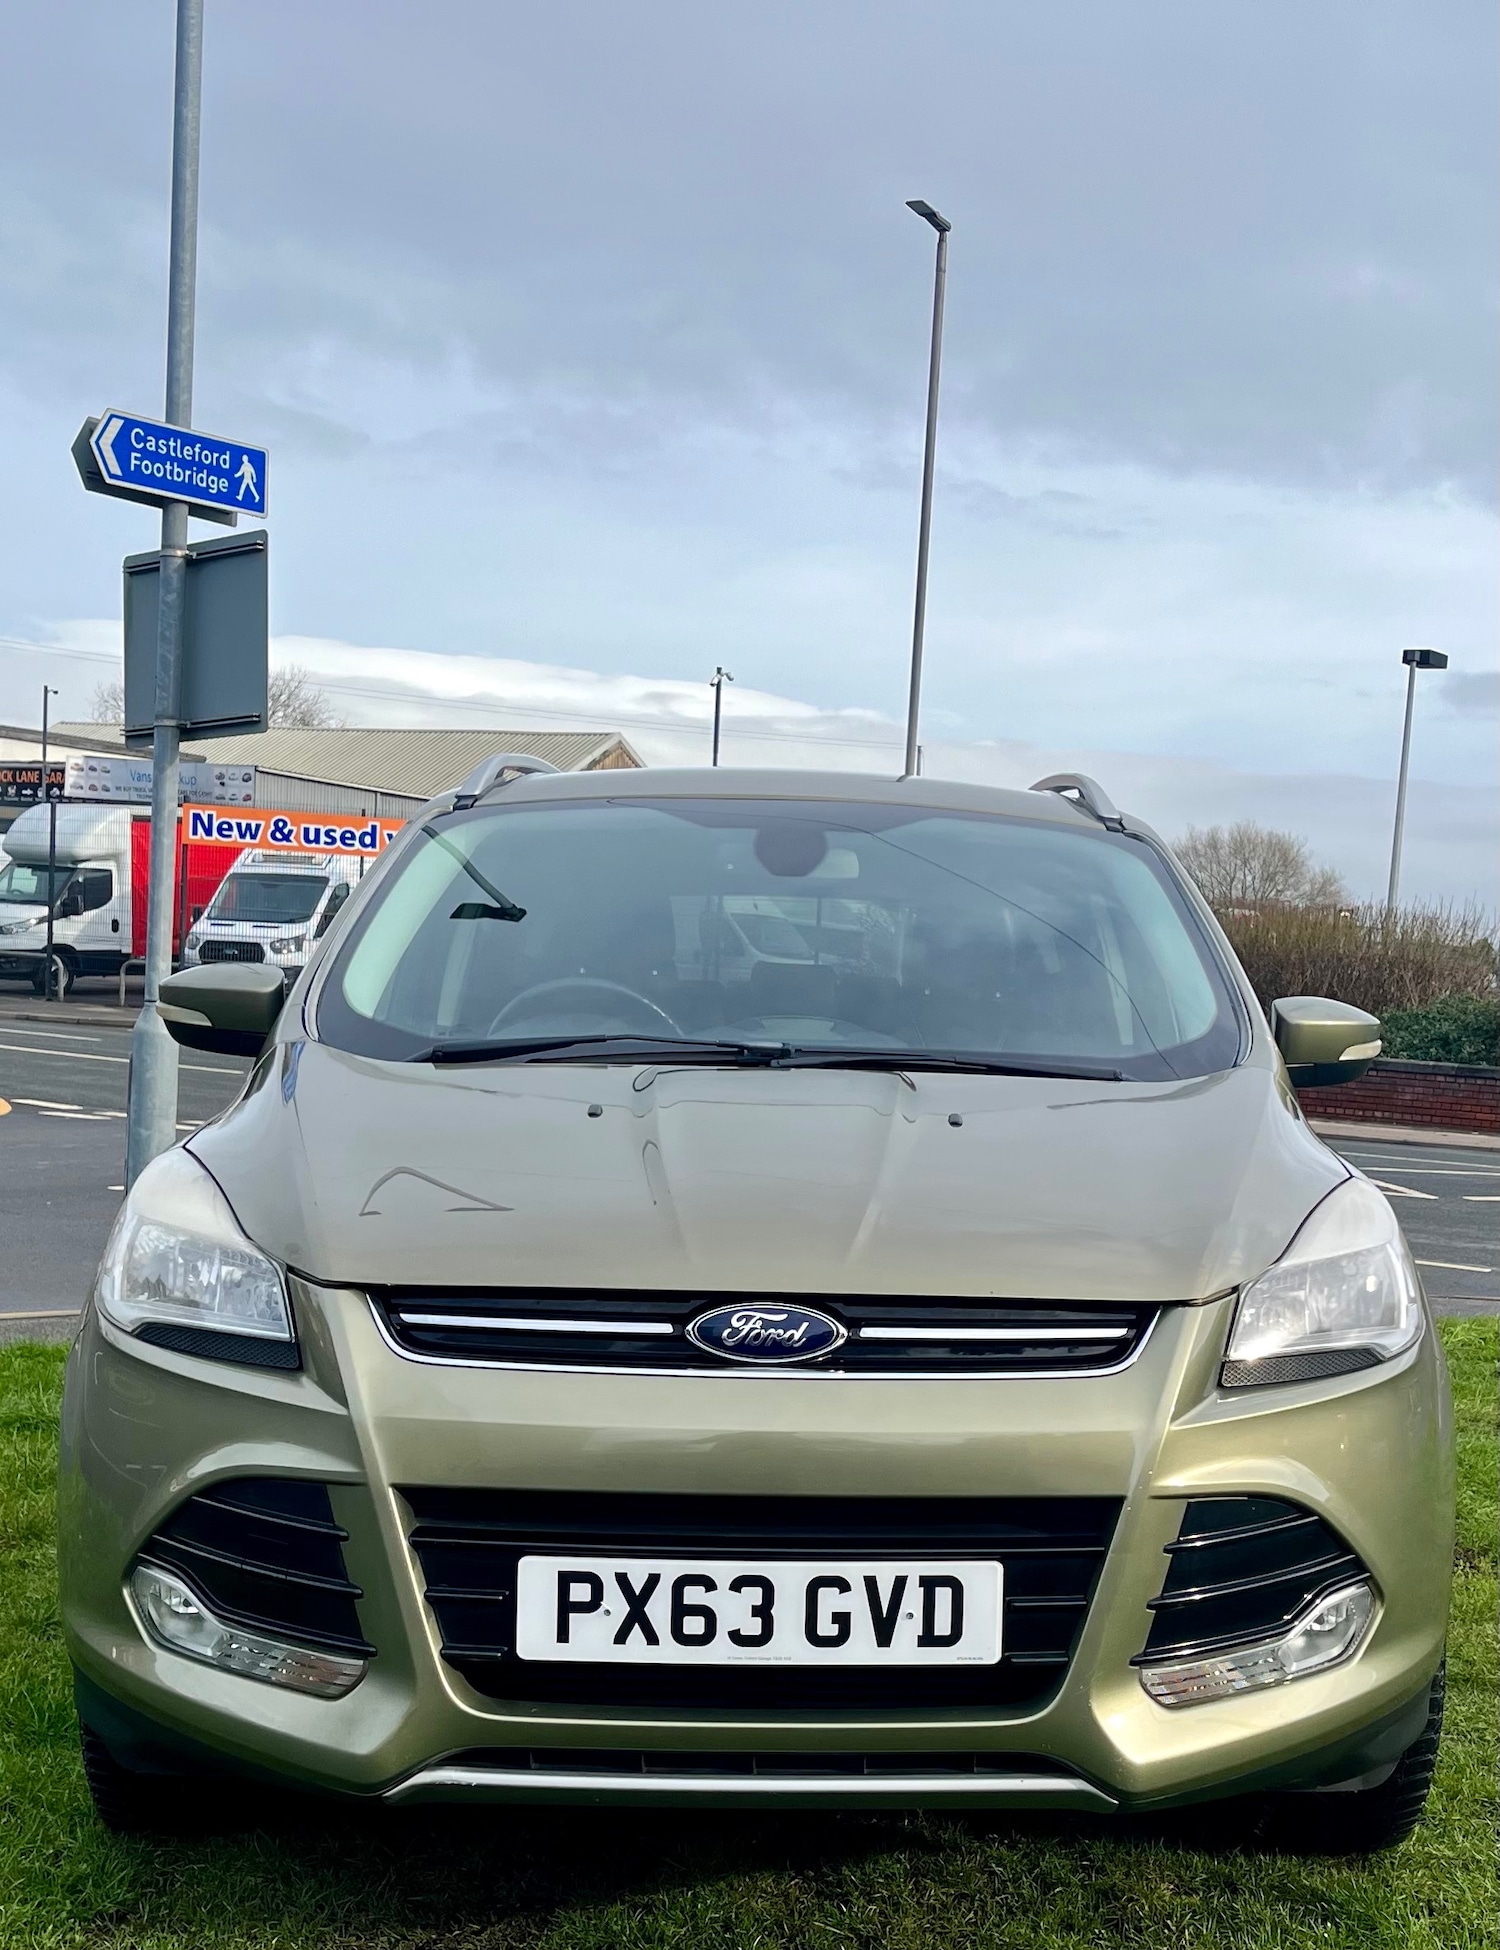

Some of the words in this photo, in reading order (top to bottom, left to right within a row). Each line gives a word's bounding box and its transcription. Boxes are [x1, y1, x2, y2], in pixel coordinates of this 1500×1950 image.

[130, 427, 230, 470] Castleford
[130, 452, 229, 494] Footbridge
[16, 770, 40, 783] LANE
[129, 768, 152, 783] Vans
[191, 811, 262, 840] New
[269, 818, 294, 843] &
[303, 824, 377, 849] used
[721, 1311, 810, 1348] Ford
[556, 1570, 775, 1648] PX63
[804, 1574, 965, 1649] GVD
